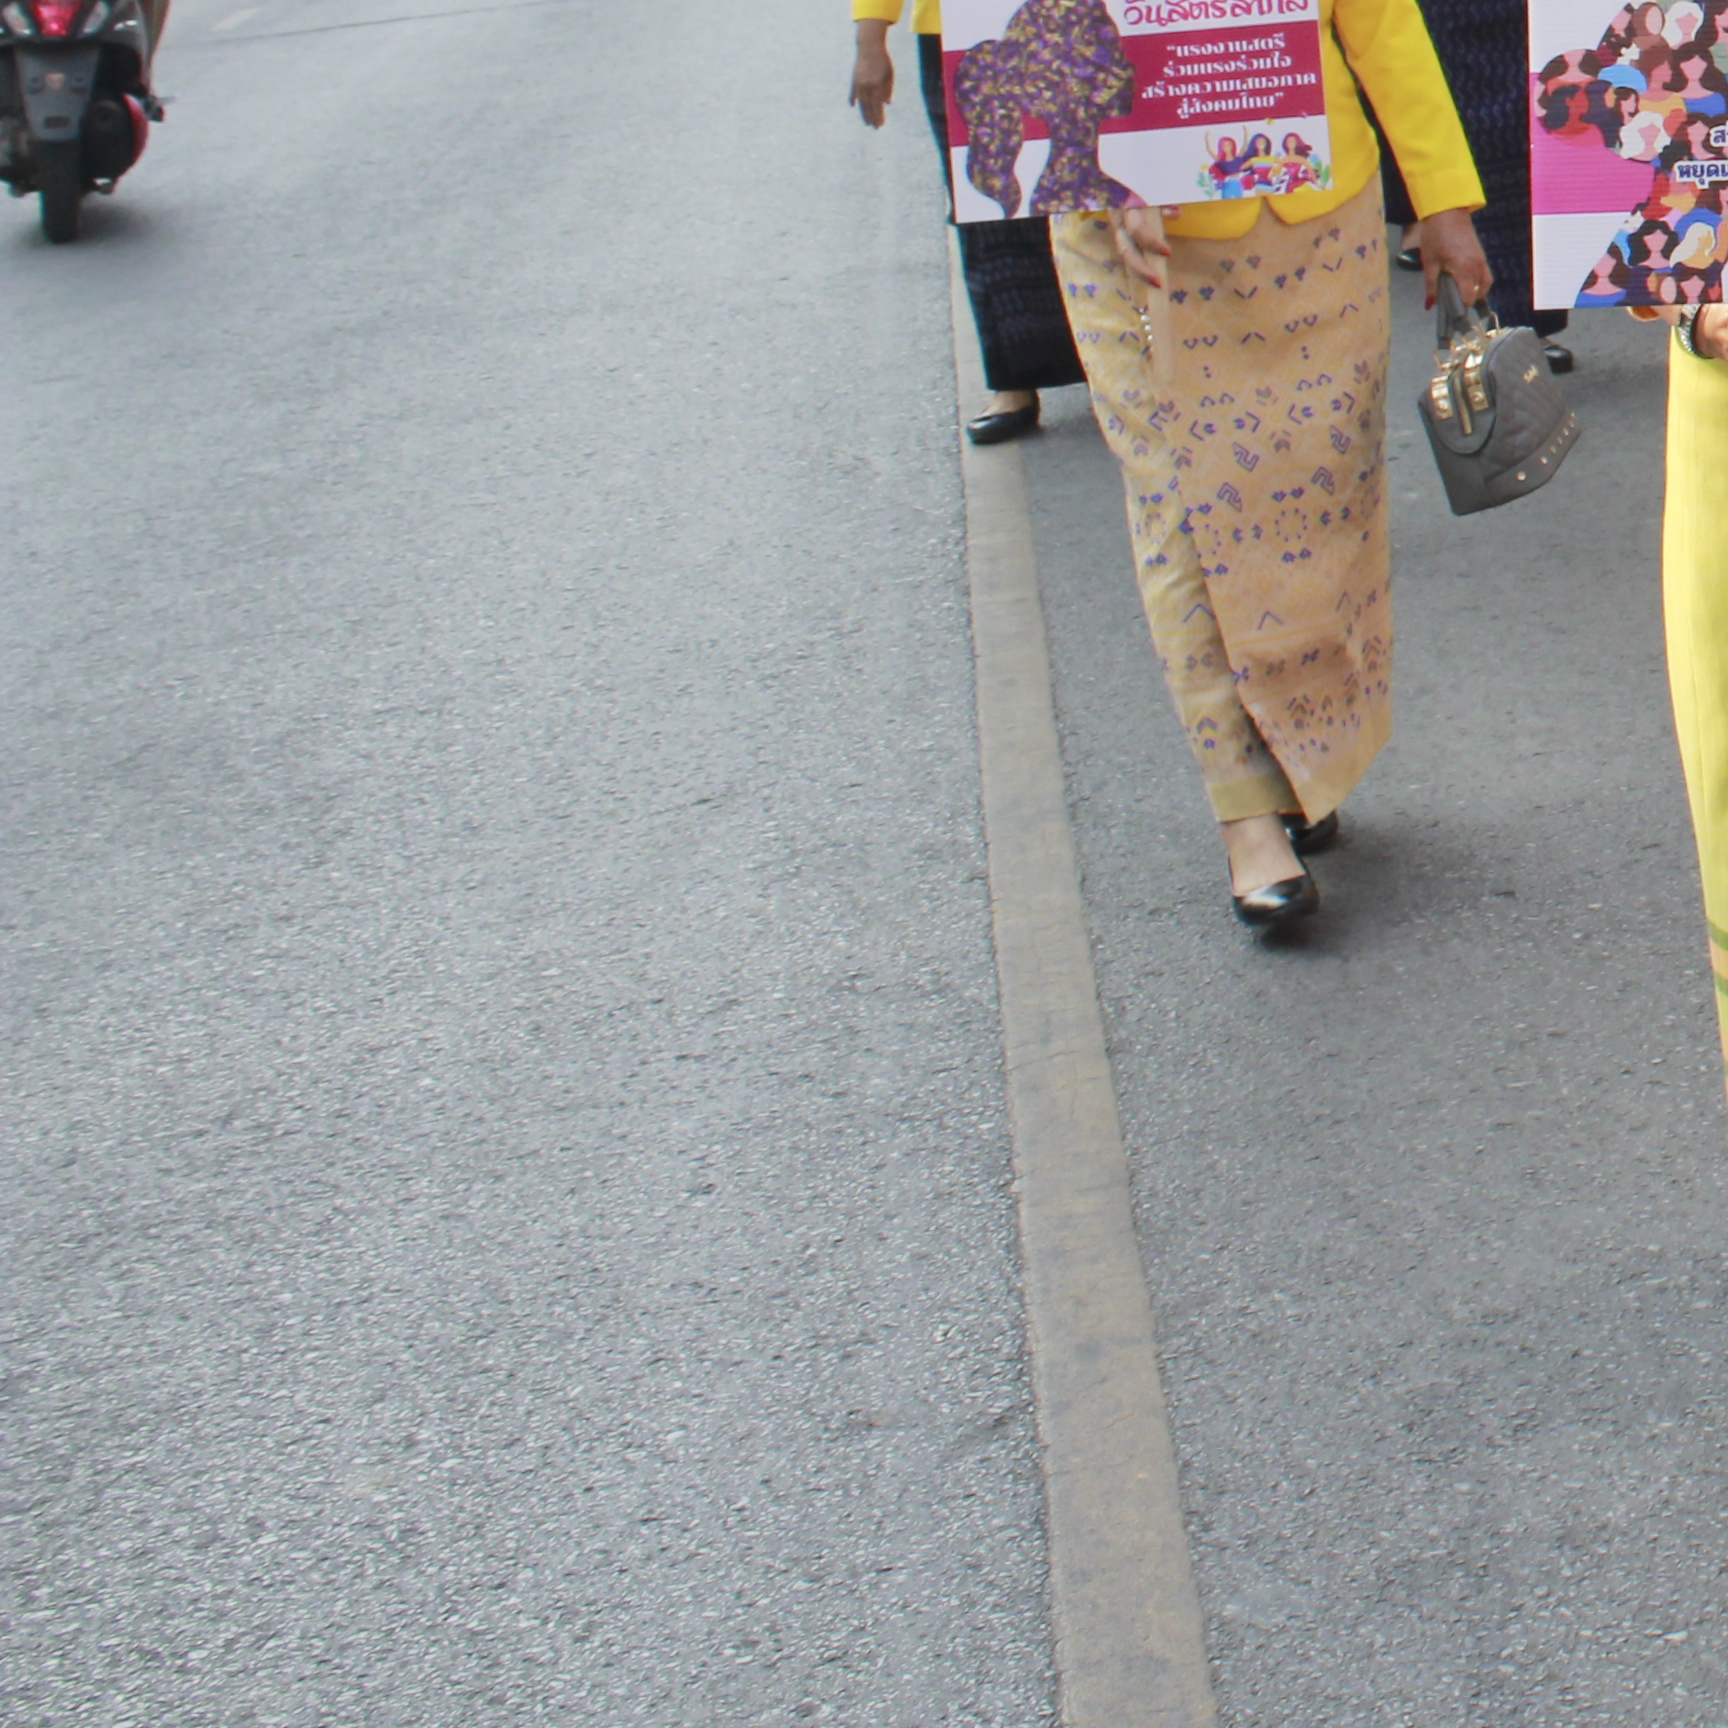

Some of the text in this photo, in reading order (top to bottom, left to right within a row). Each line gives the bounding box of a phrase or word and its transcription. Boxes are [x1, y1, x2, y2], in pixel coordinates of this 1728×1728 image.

[1166, 31, 1286, 59] “แรงงานสตรี
[1163, 51, 1293, 81] ร่วมแรงร่วมใจ
[1141, 72, 1317, 101] สร้างความเสมอภาค
[1176, 92, 1285, 120] สู่สังคมไทย”
